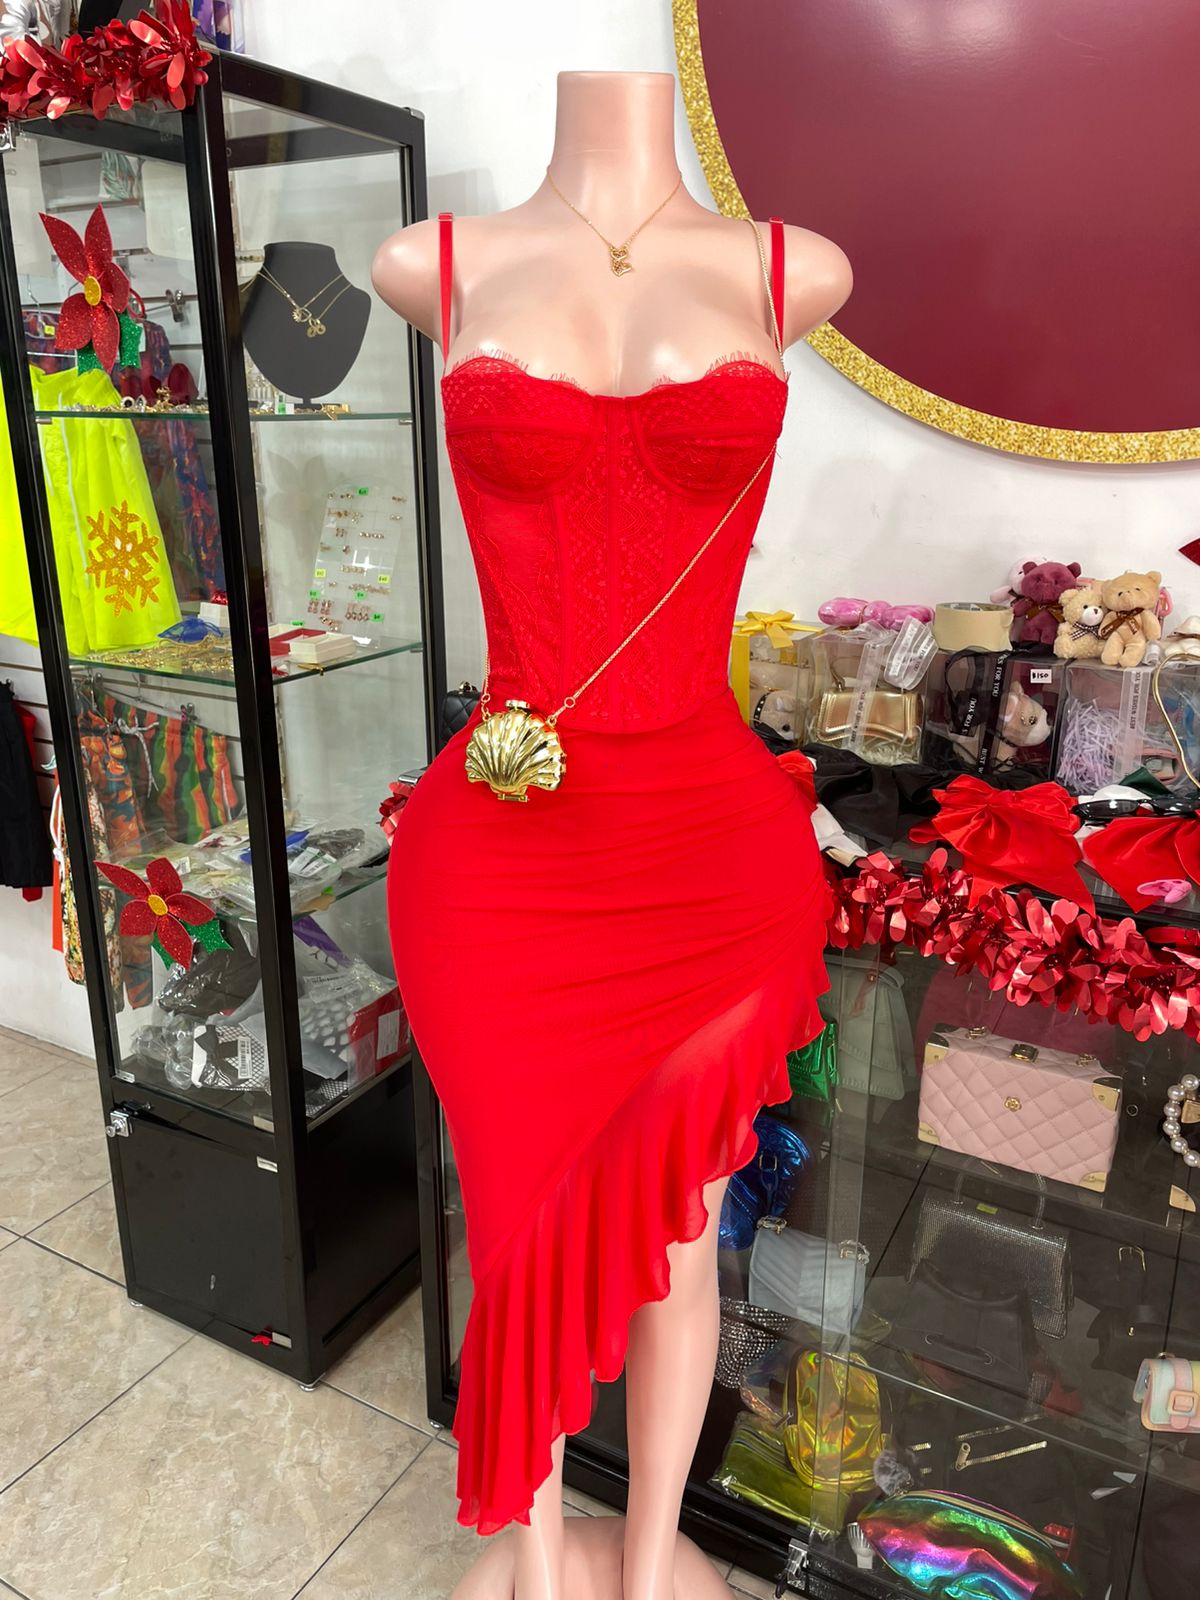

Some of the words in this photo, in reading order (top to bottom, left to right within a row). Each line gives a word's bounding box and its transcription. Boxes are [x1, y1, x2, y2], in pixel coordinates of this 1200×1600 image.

[992, 682, 1000, 697] YOU
[968, 697, 977, 713] YOU
[964, 714, 974, 728] FOR
